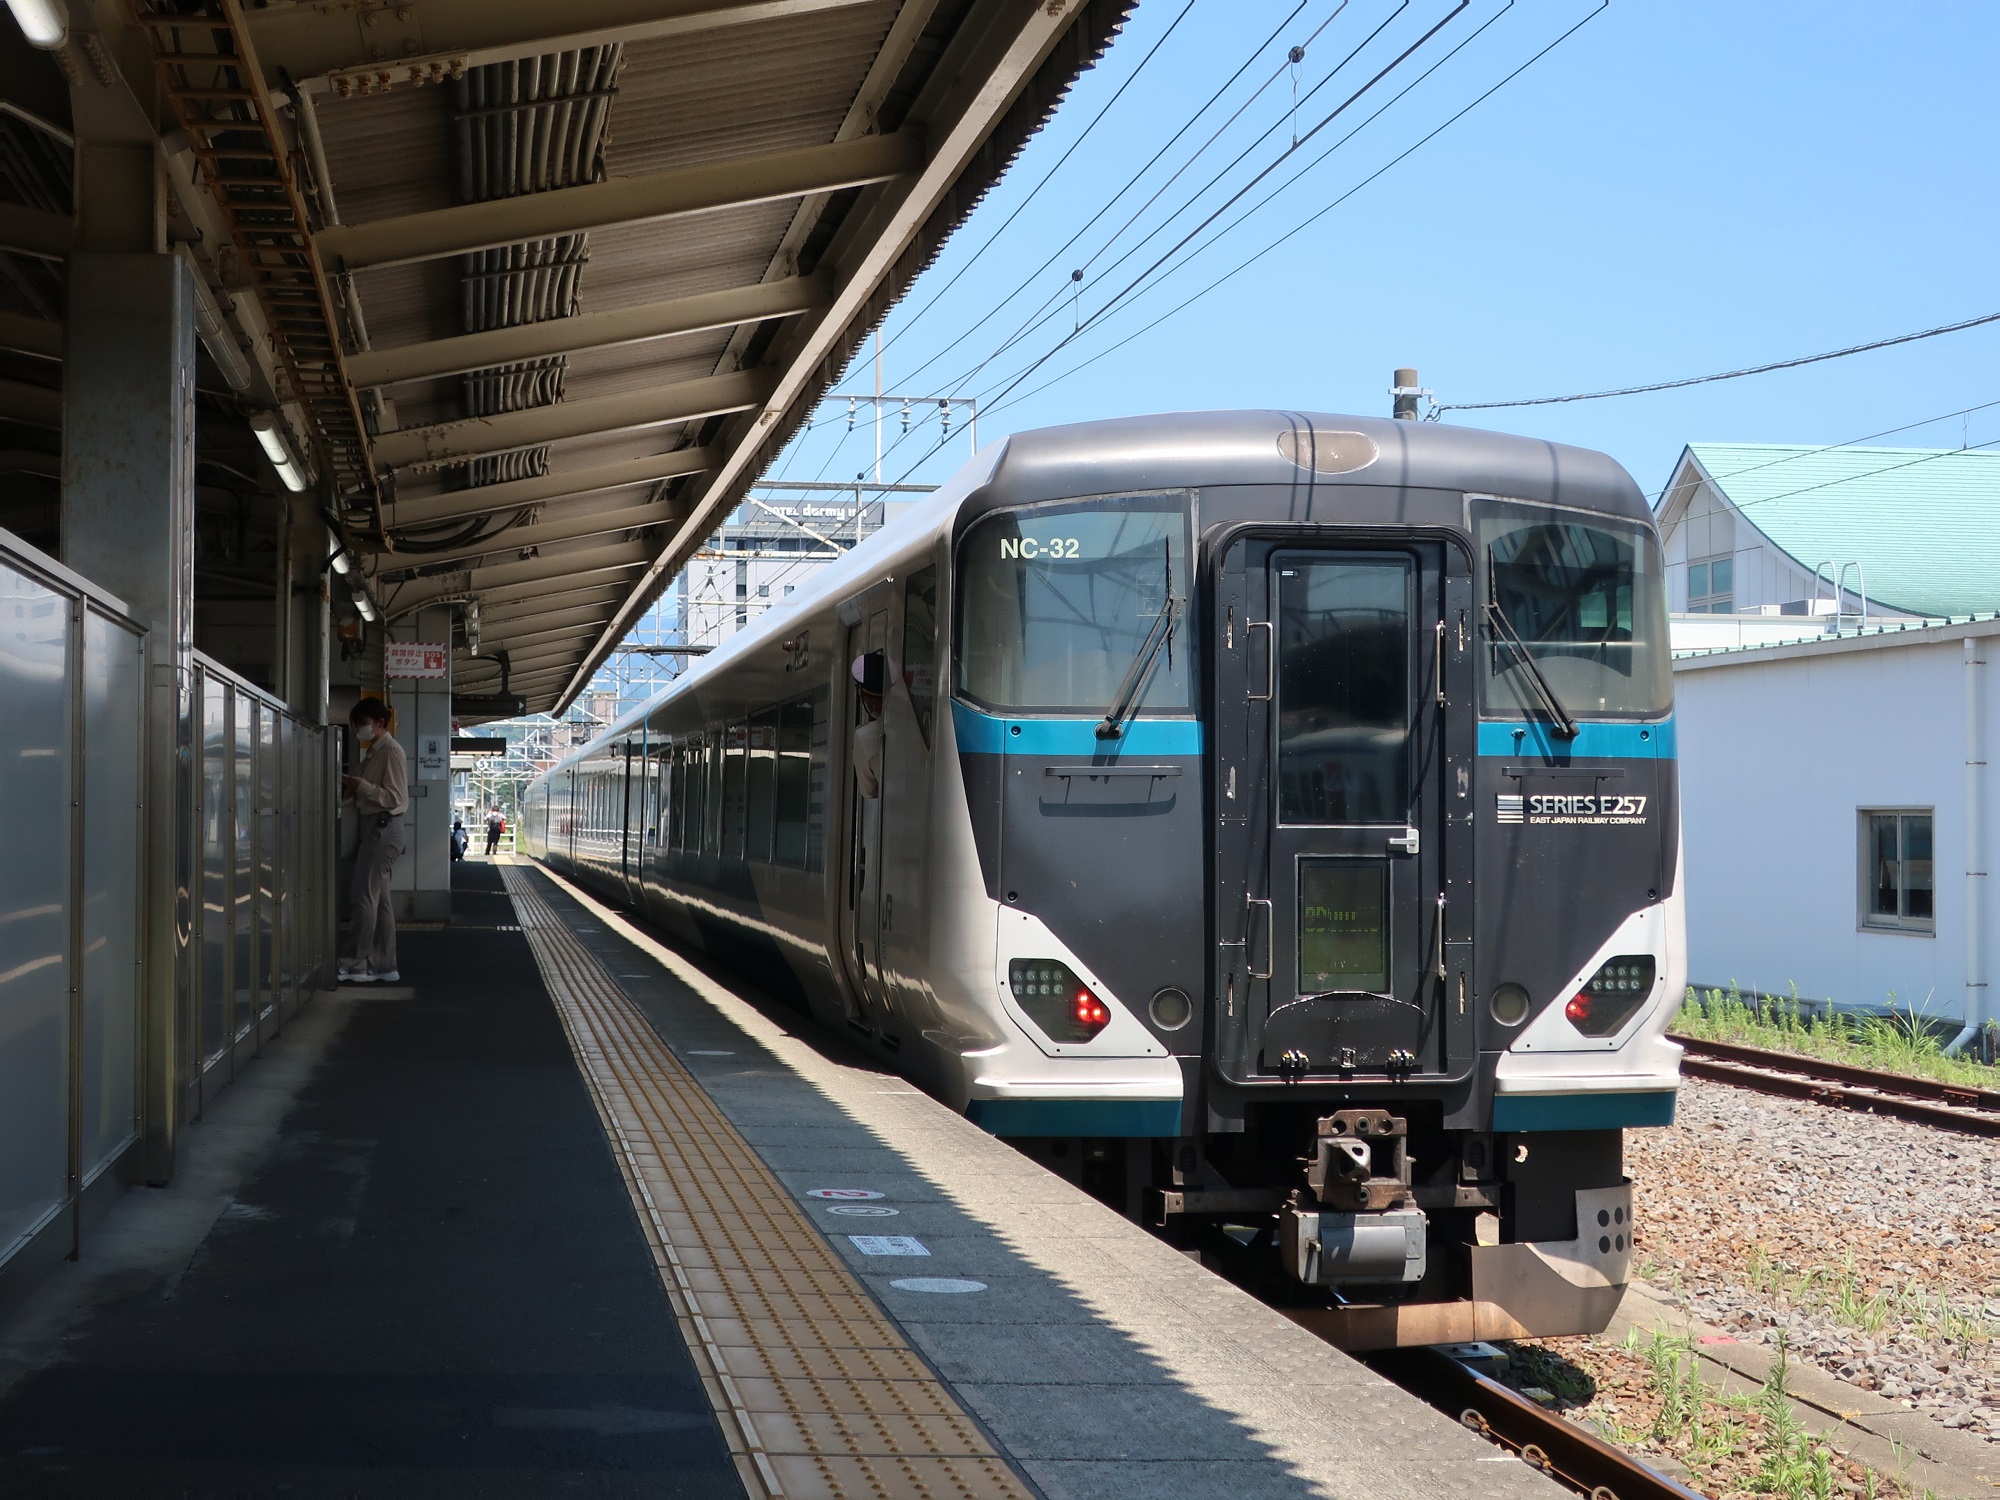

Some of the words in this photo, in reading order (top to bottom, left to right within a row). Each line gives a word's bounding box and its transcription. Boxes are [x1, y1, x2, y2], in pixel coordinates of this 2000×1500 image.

[1000, 537, 1080, 559] NC-32
[391, 649, 423, 658] 非常停止
[395, 658, 419, 666] ボタン
[479, 760, 485, 768] 5
[1529, 795, 1597, 815] SERIES
[1600, 796, 1647, 815] E257
[1529, 816, 1552, 824] EAST
[1551, 816, 1577, 824] JAPAN
[1577, 817, 1609, 825] RAILWAY
[1609, 817, 1647, 825] COMPANY
[820, 1190, 870, 1198] 2
